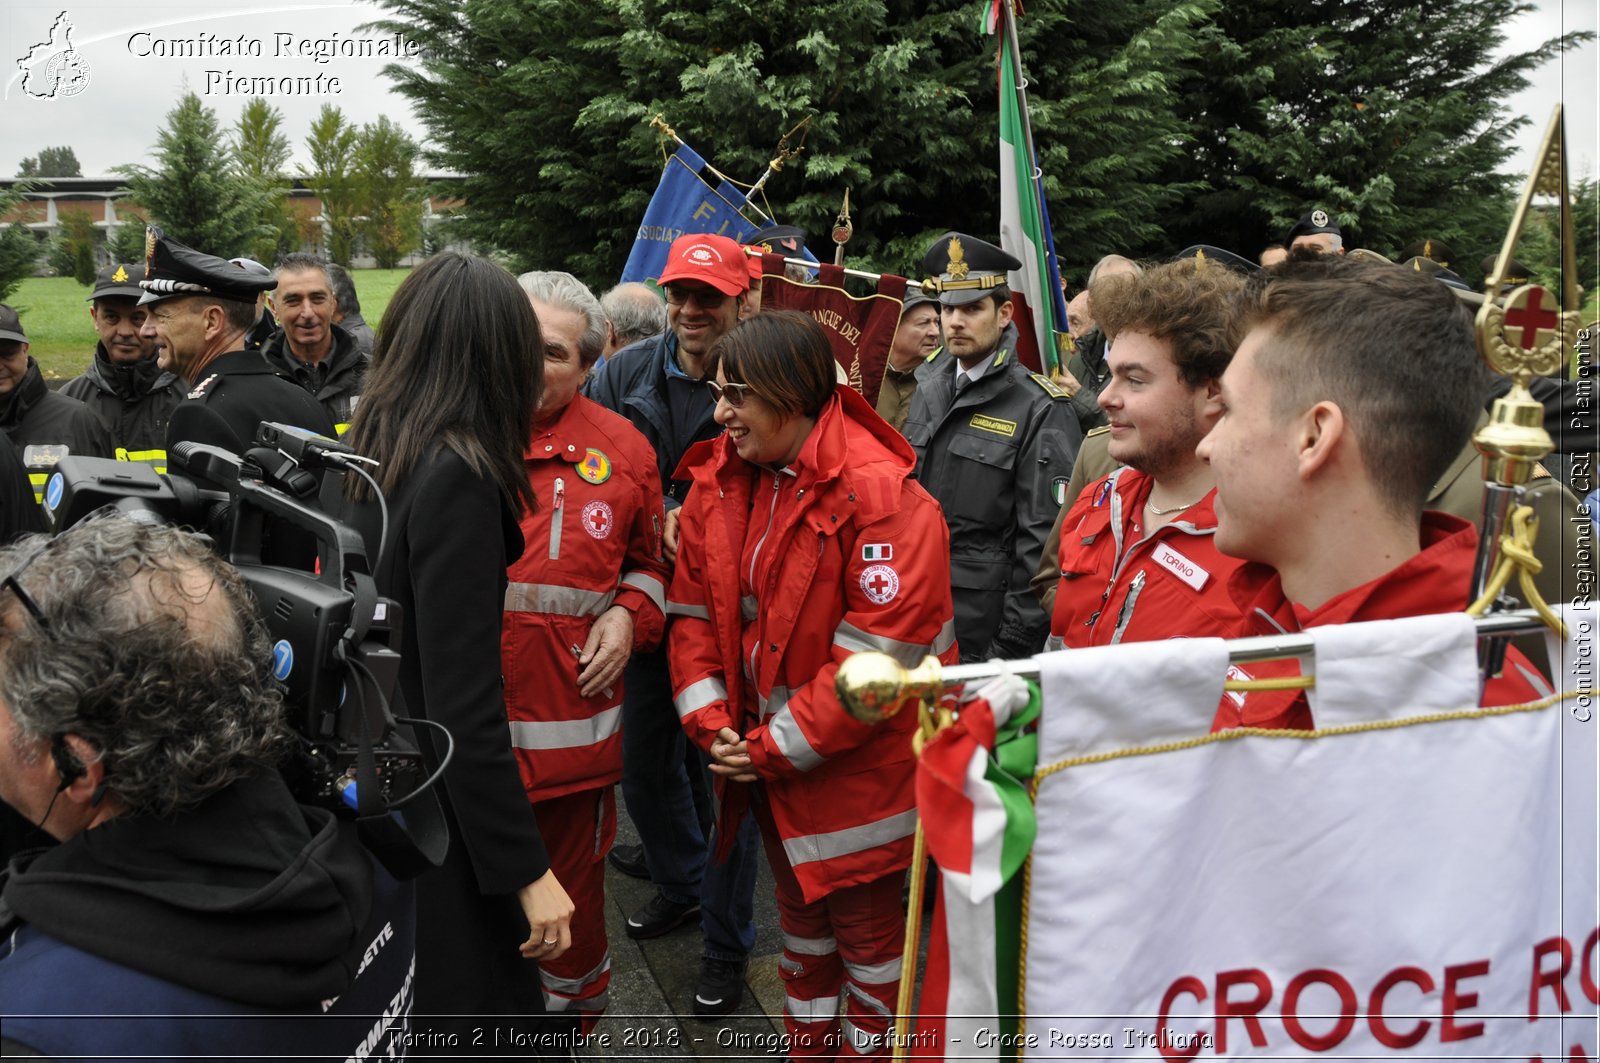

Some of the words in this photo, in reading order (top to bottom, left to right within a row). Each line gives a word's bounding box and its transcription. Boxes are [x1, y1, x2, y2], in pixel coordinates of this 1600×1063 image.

[805, 309, 842, 331] ANGUE
[839, 321, 861, 346] DEL
[1162, 552, 1194, 577] TORINO
[276, 644, 290, 675] 7
[1156, 958, 1490, 1063] CROCE
